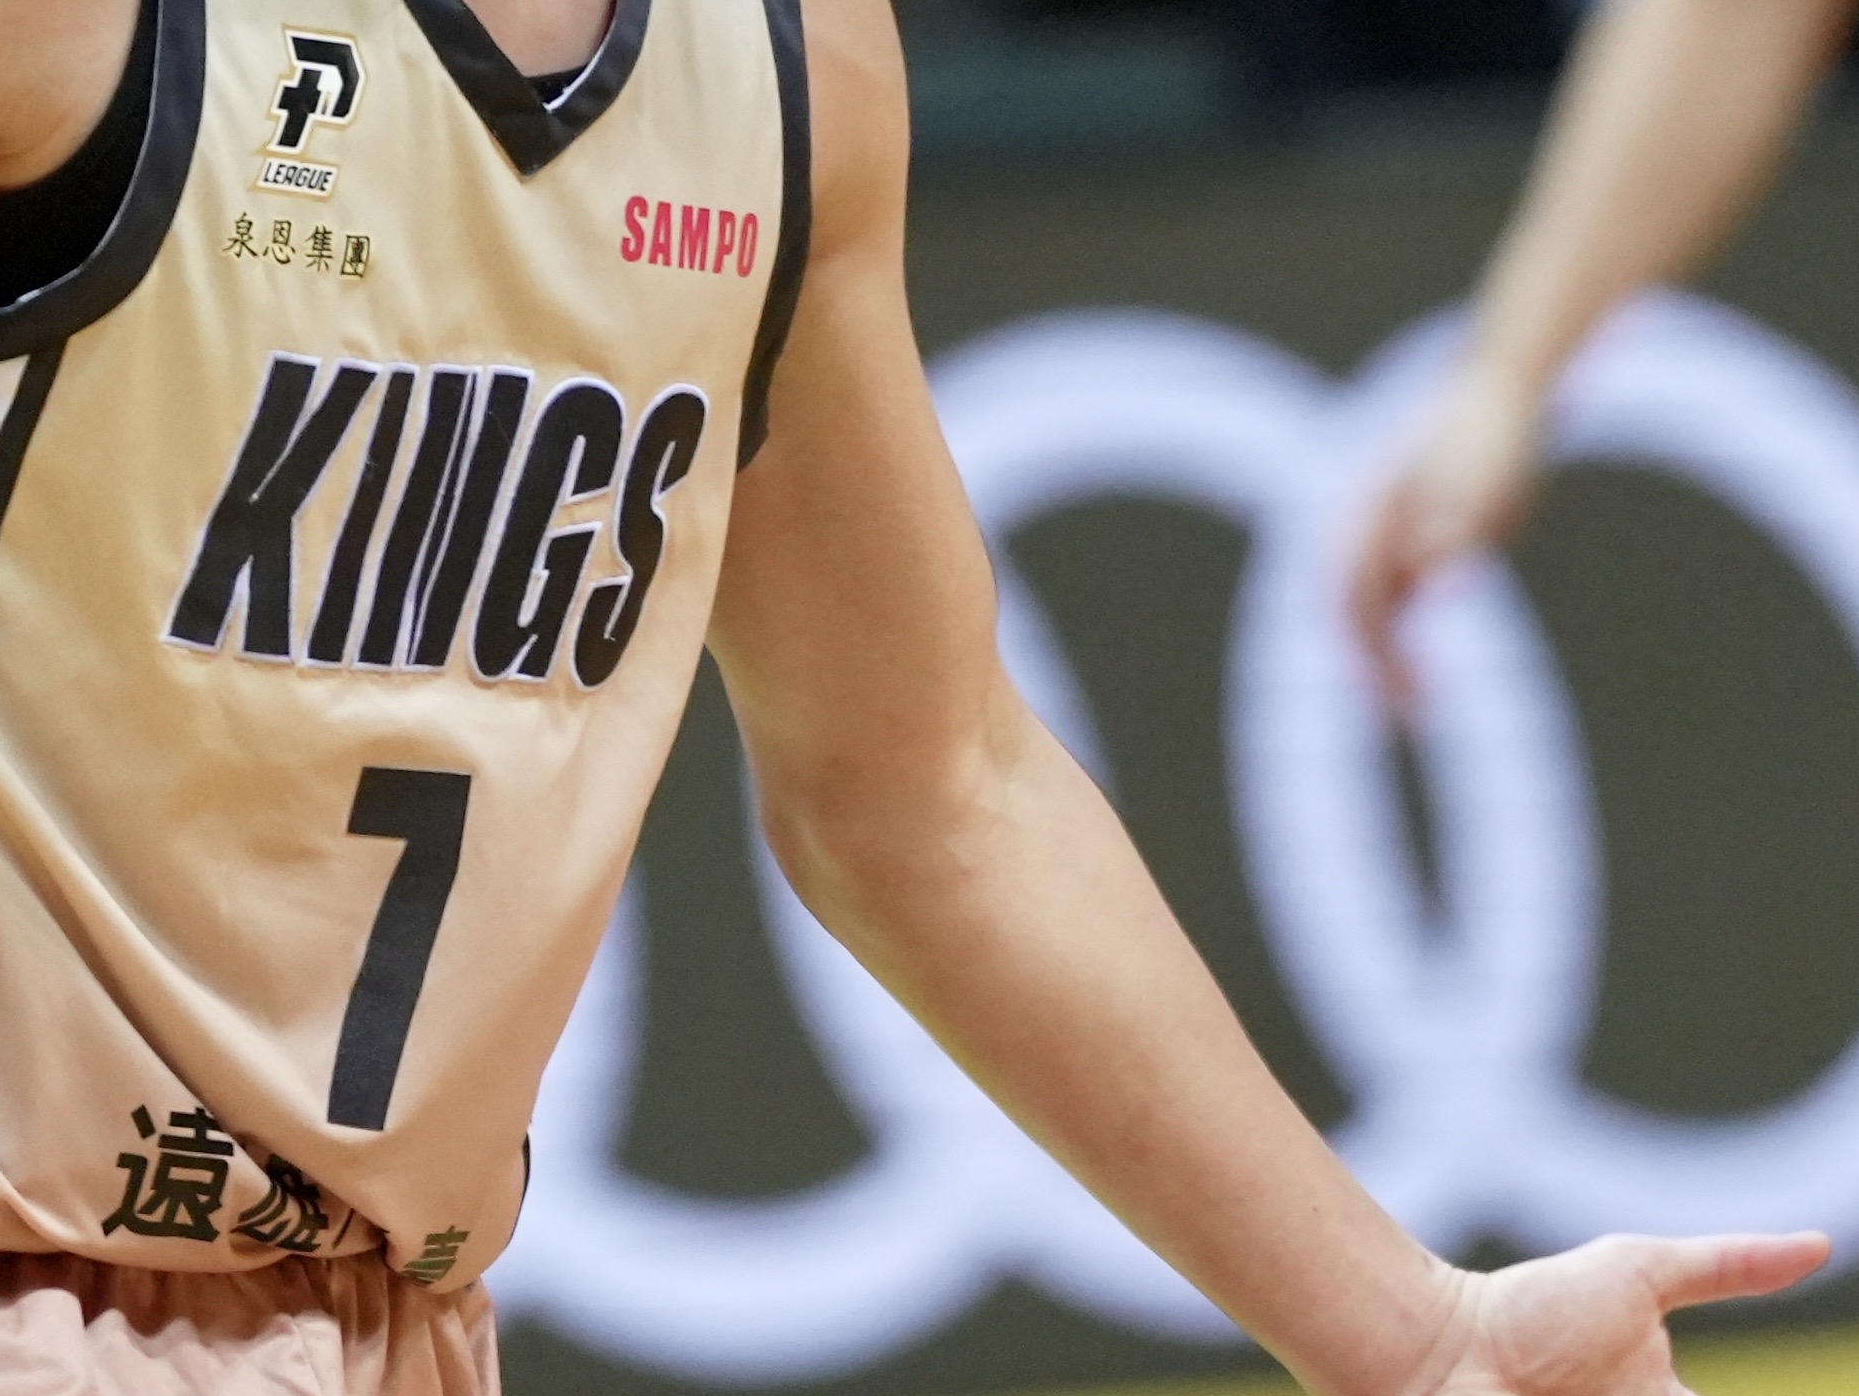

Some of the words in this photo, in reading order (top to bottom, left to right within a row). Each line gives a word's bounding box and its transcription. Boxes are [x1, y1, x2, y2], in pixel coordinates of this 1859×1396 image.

[260, 160, 335, 193] LEAGUE
[222, 211, 371, 279] 泉恩集團
[620, 194, 759, 278] SAMPO
[161, 350, 710, 690] KINGS
[327, 766, 473, 1132] 7
